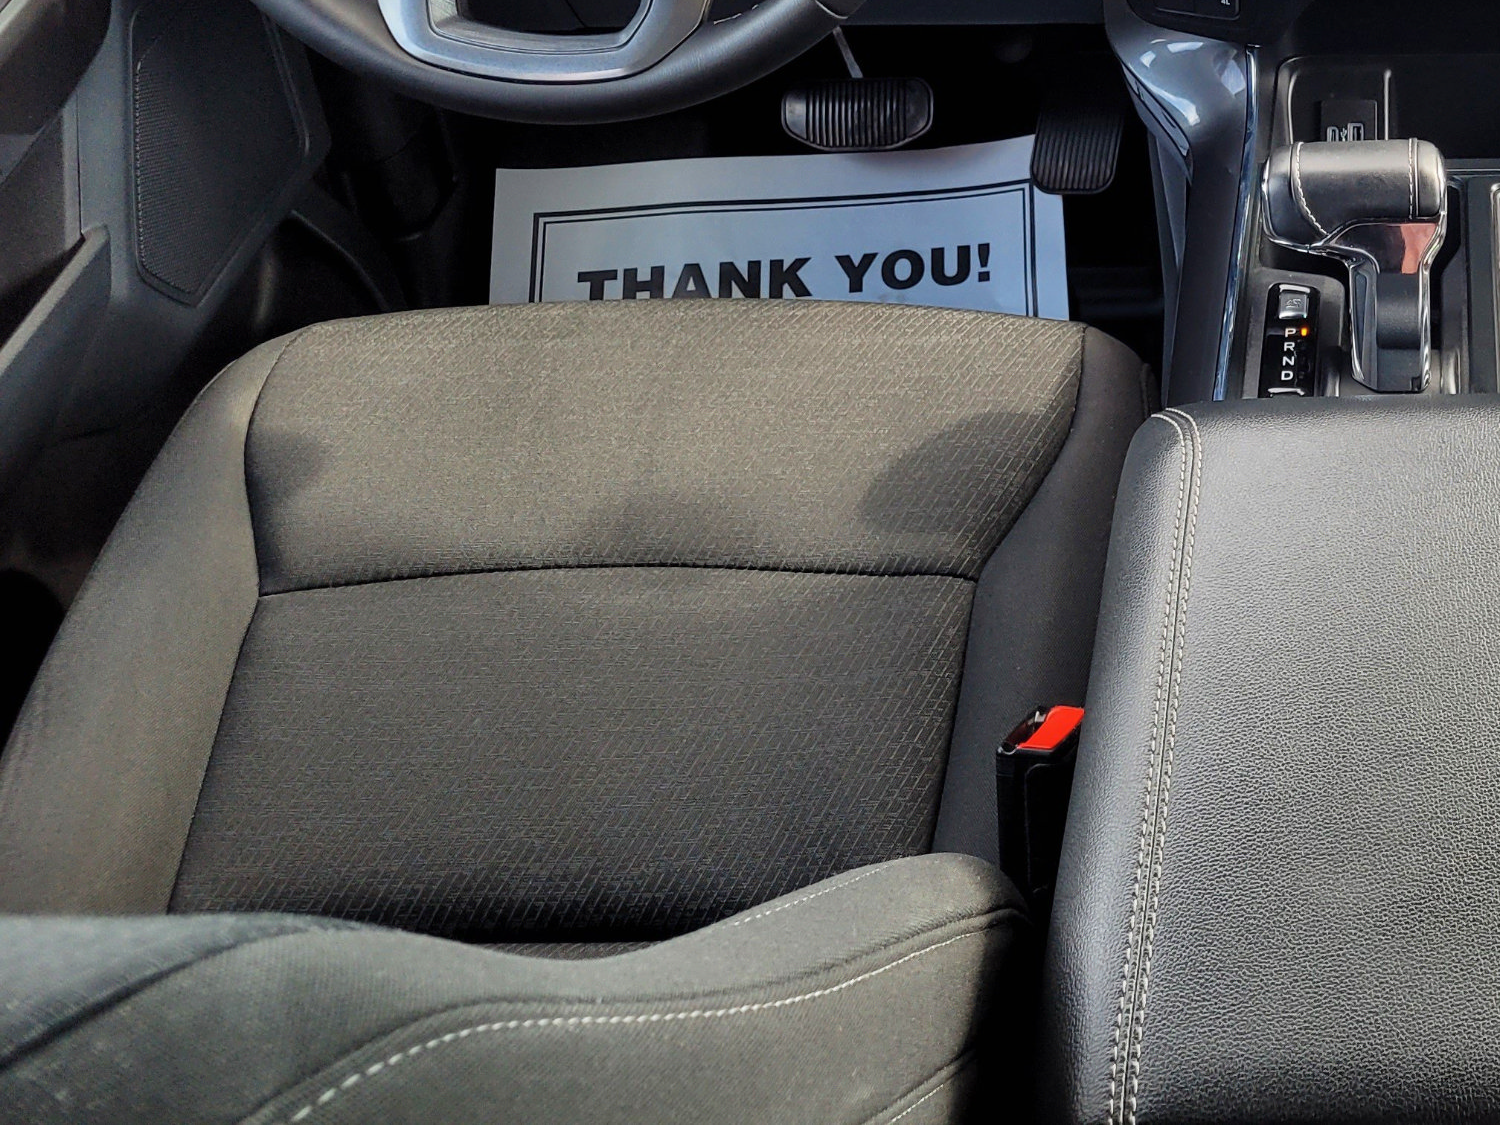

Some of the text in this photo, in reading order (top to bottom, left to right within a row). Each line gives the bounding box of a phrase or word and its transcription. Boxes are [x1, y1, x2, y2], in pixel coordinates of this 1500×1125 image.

[577, 243, 992, 299] THANK YOU!
[1285, 328, 1296, 338] P
[1284, 341, 1295, 352] R
[1282, 356, 1295, 366] N
[1281, 370, 1293, 381] D
